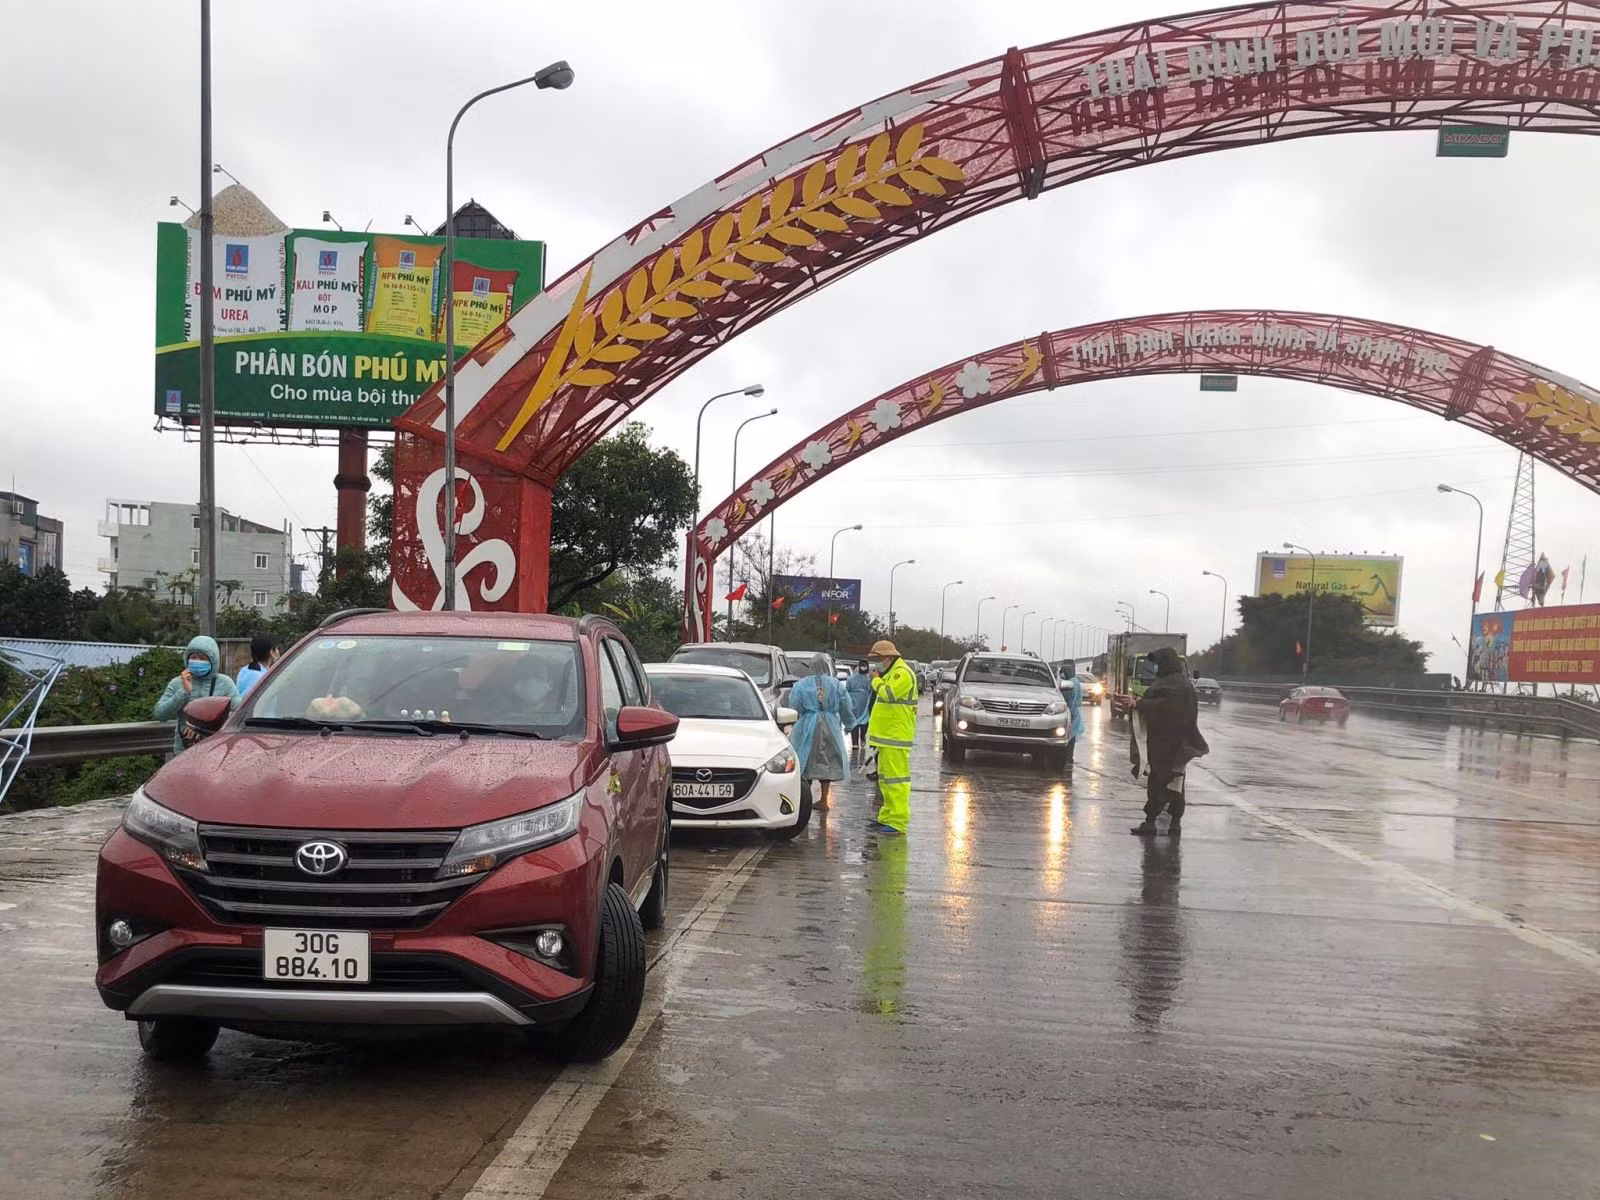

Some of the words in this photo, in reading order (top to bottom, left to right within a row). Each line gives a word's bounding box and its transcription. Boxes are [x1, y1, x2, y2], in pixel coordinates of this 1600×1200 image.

[1539, 24, 1600, 66] PH
[1443, 134, 1502, 144] MIKADO
[381, 272, 396, 281] NPK
[398, 271, 415, 282] PHÚ
[194, 282, 222, 300] ĐM
[225, 286, 252, 302] PHÚ
[256, 284, 276, 300] MỸ
[296, 280, 314, 290] KALI
[317, 279, 338, 290] PHÚ
[341, 280, 358, 293] MỸ
[470, 300, 488, 310] PHÚ
[221, 308, 248, 321] UREA
[235, 348, 295, 376] PHÂN
[302, 350, 347, 378] BÓN
[354, 351, 407, 381] PHÚ
[270, 384, 307, 400] Cho
[312, 386, 352, 401] mùa
[358, 388, 385, 407] bội
[1296, 581, 1329, 590] Natural
[1331, 582, 1348, 590] Gas
[295, 932, 339, 954] 30G
[276, 956, 358, 979] 884.10
